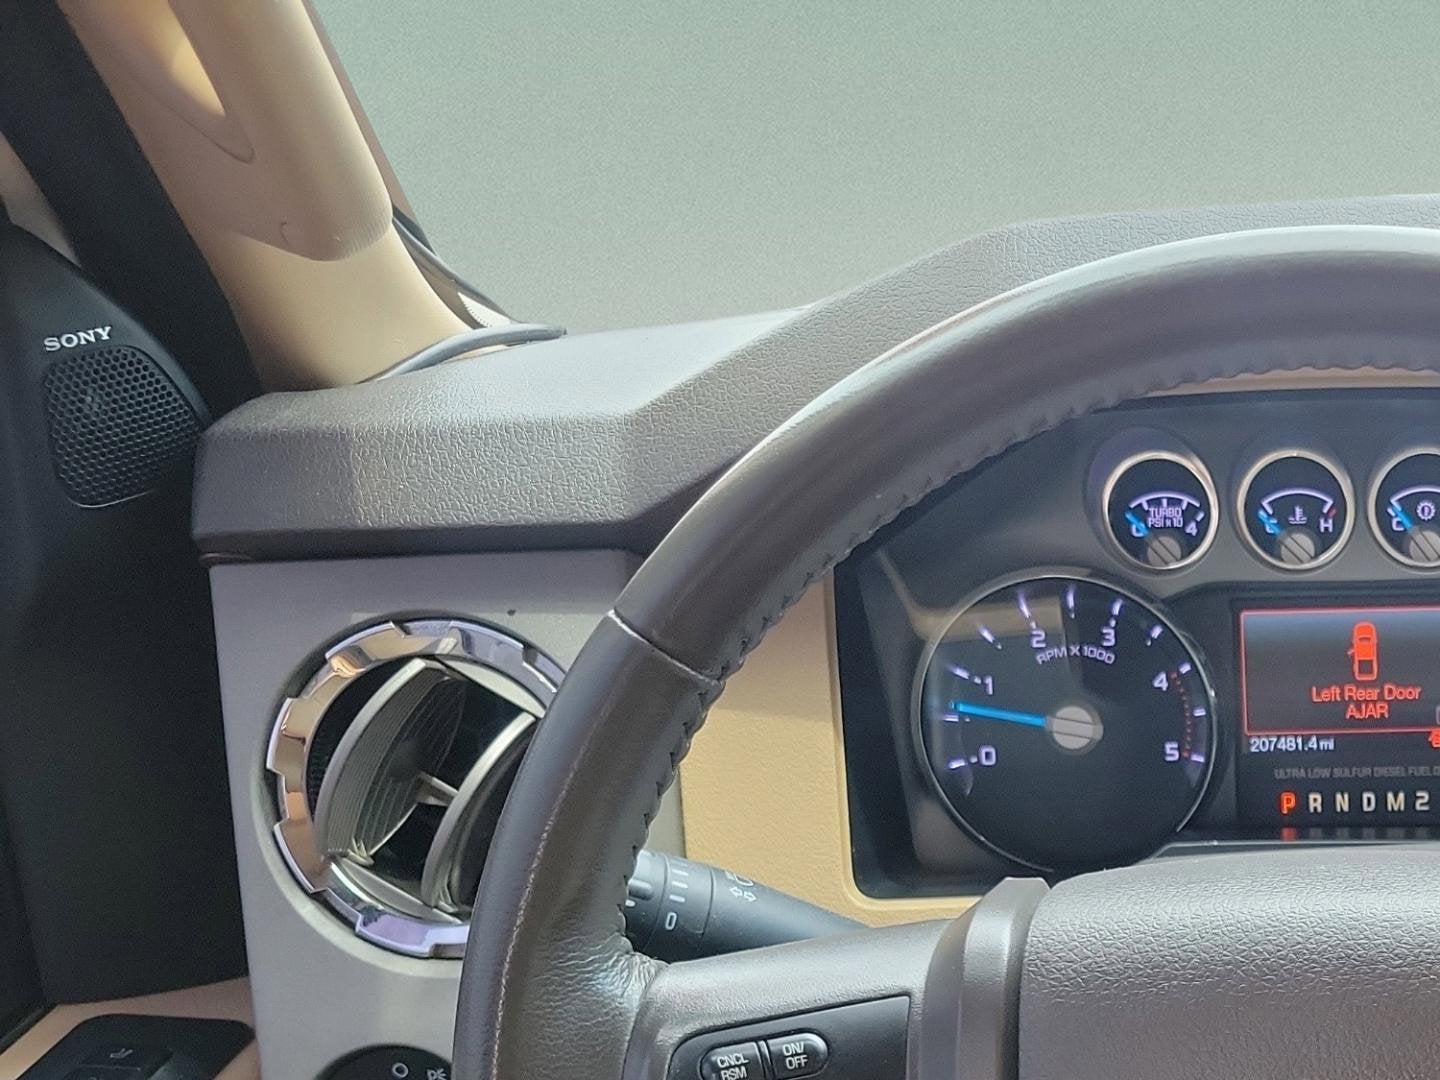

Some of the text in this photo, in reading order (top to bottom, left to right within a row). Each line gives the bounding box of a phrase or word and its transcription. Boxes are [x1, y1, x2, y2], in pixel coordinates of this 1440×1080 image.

[43, 326, 112, 351] SONY
[1148, 507, 1183, 518] TURBO
[1185, 521, 1198, 536] 4
[1320, 518, 1333, 533] H
[1031, 629, 1046, 648] 2
[1102, 627, 1116, 647] 3
[1036, 645, 1115, 665] RPM X 1000
[983, 675, 993, 695] 1
[1153, 671, 1169, 692] 4
[1311, 685, 1421, 702] Left Rear Door
[1345, 704, 1389, 719] AJAR
[979, 746, 996, 766] 0
[1164, 741, 1179, 761] 5
[1273, 768, 1307, 779] ULTRA
[1308, 767, 1331, 779] LOW
[1333, 766, 1373, 778] SULFUR
[1374, 765, 1407, 777] DIESEL
[1408, 765, 1432, 777] FUEL
[1280, 791, 1296, 814] P
[1308, 792, 1322, 813] R
[1335, 792, 1350, 813] N
[1362, 791, 1376, 812] D
[1387, 791, 1405, 812] M
[1415, 790, 1430, 811] 2
[782, 1042, 805, 1057] ON/
[717, 1053, 749, 1068] CNCL
[785, 1054, 808, 1070] OFF
